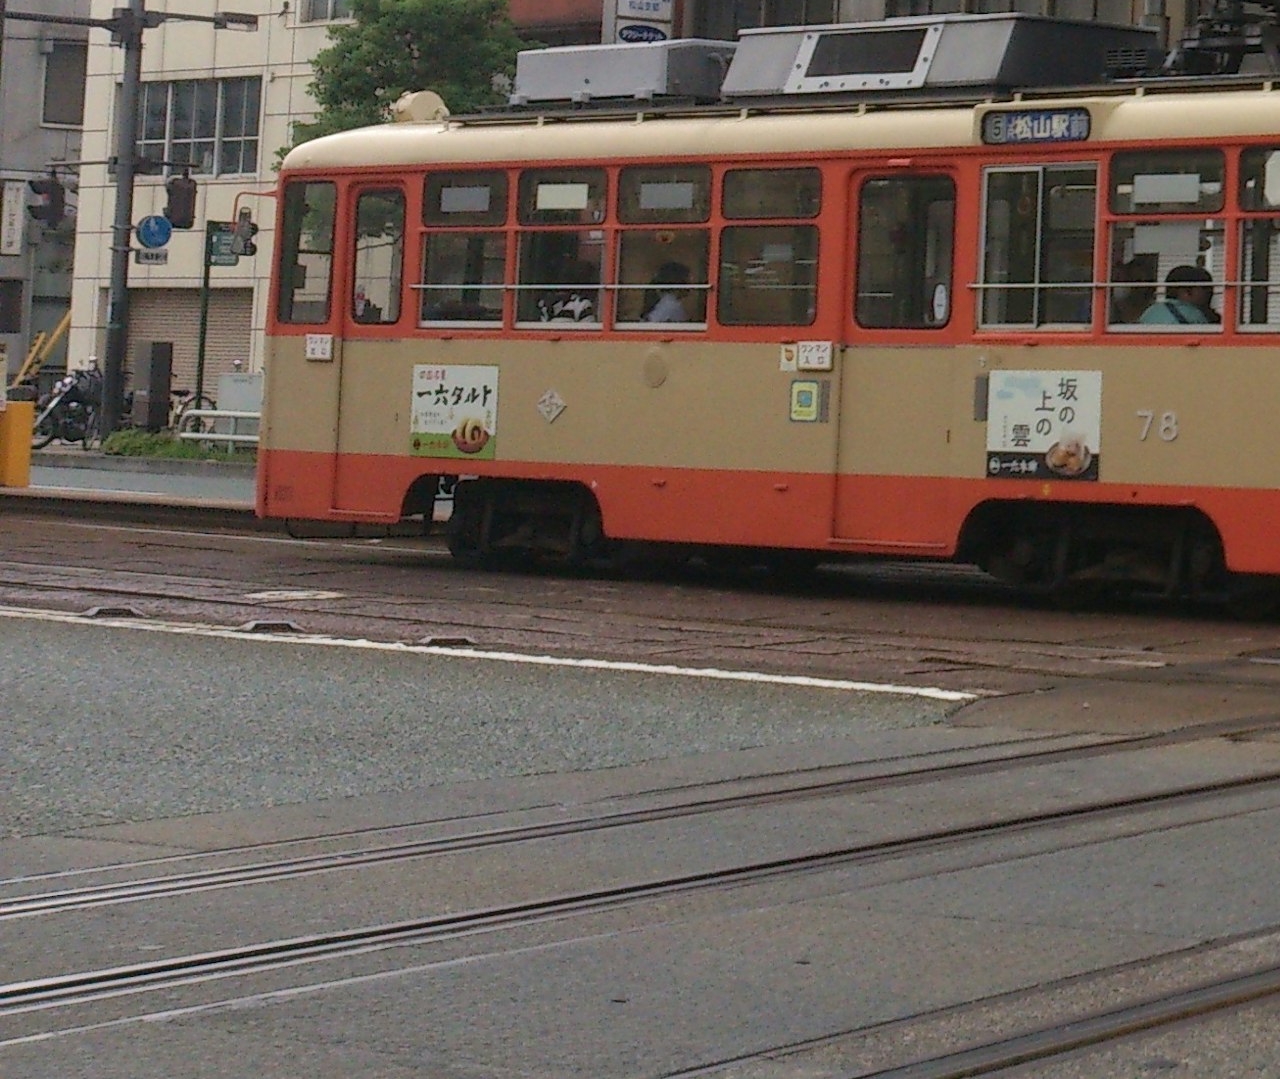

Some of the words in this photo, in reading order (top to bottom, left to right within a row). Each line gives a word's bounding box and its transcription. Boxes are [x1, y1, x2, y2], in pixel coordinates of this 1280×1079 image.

[416, 383, 493, 408] 一六タルト
[1057, 377, 1078, 424] 坂の
[1034, 389, 1055, 436] 上の
[1135, 409, 1178, 442] 78
[1010, 424, 1031, 448] 雲
